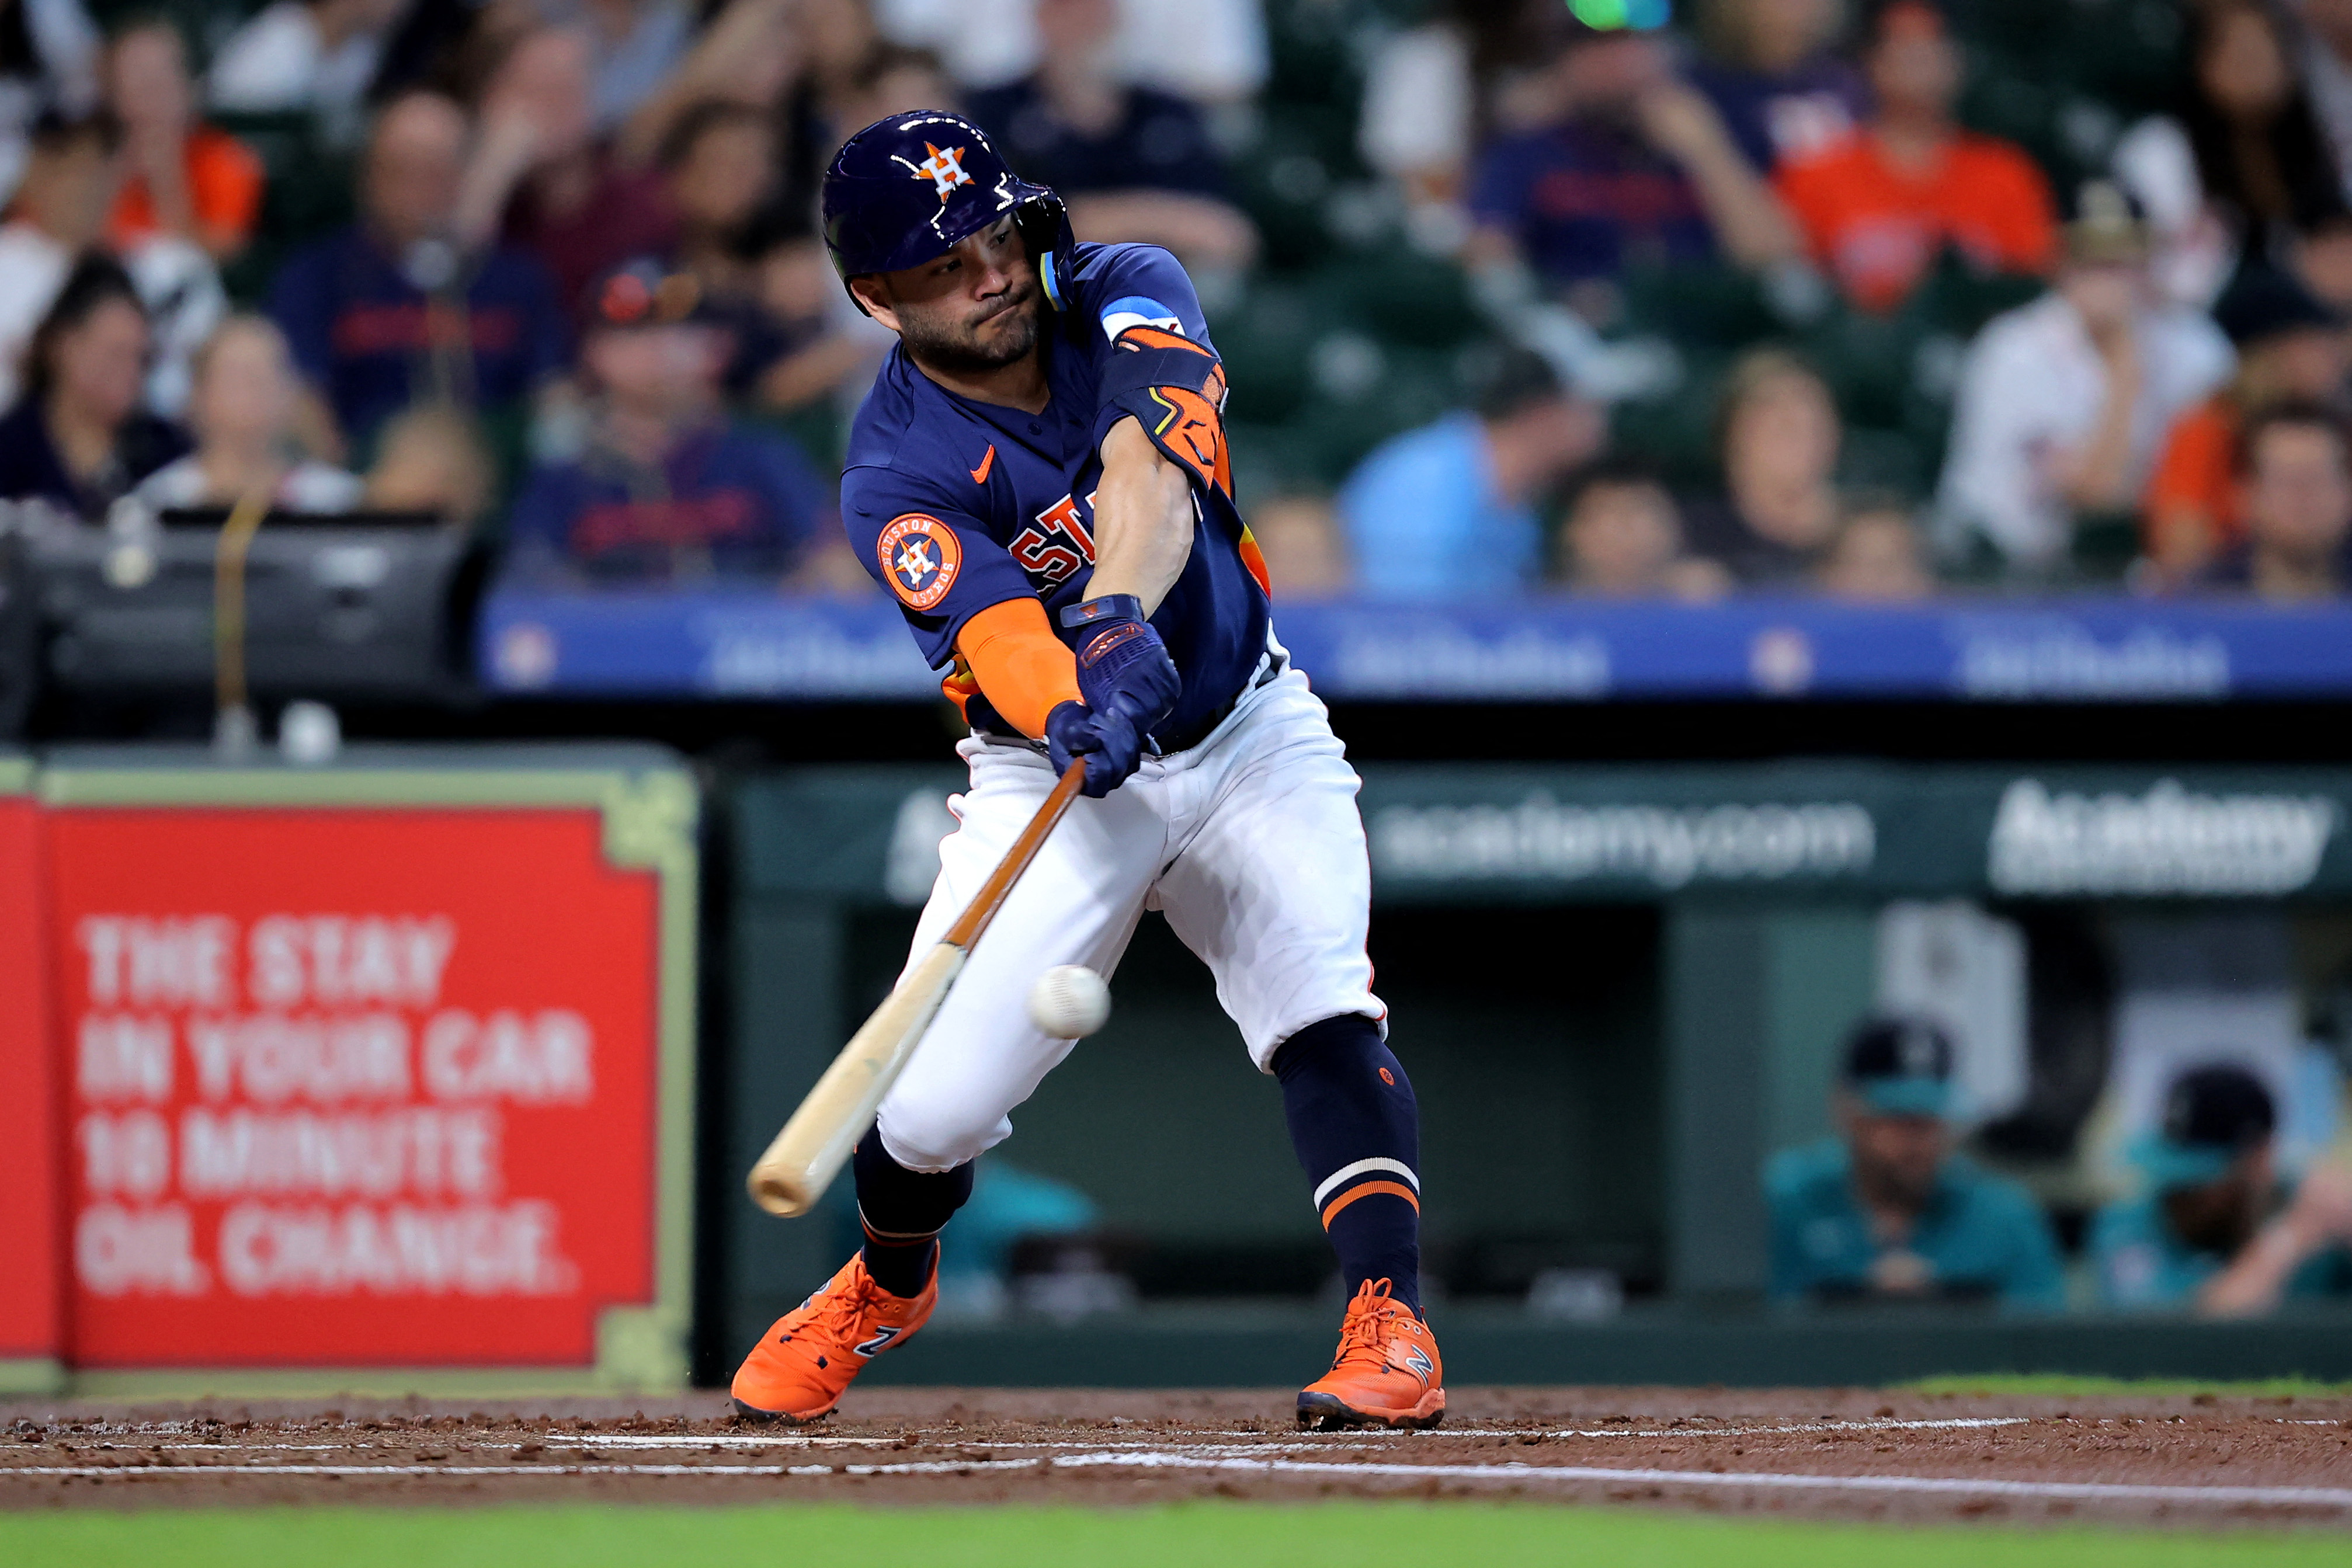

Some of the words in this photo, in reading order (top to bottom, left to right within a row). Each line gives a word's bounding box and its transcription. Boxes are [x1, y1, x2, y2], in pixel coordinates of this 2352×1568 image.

[919, 146, 971, 195] H
[881, 519, 933, 566] HOUSTON
[897, 540, 936, 585] H
[911, 562, 954, 604] ASTROS
[1381, 794, 1875, 886] academy.com
[1989, 780, 2335, 873] Academy
[81, 916, 232, 1004] THE
[249, 916, 453, 1006] STAY
[78, 1013, 173, 1100] IN
[187, 1012, 412, 1101] YOUR
[421, 1010, 592, 1104] CAR
[180, 1108, 501, 1197] MINUTE
[77, 1203, 206, 1294] OIL
